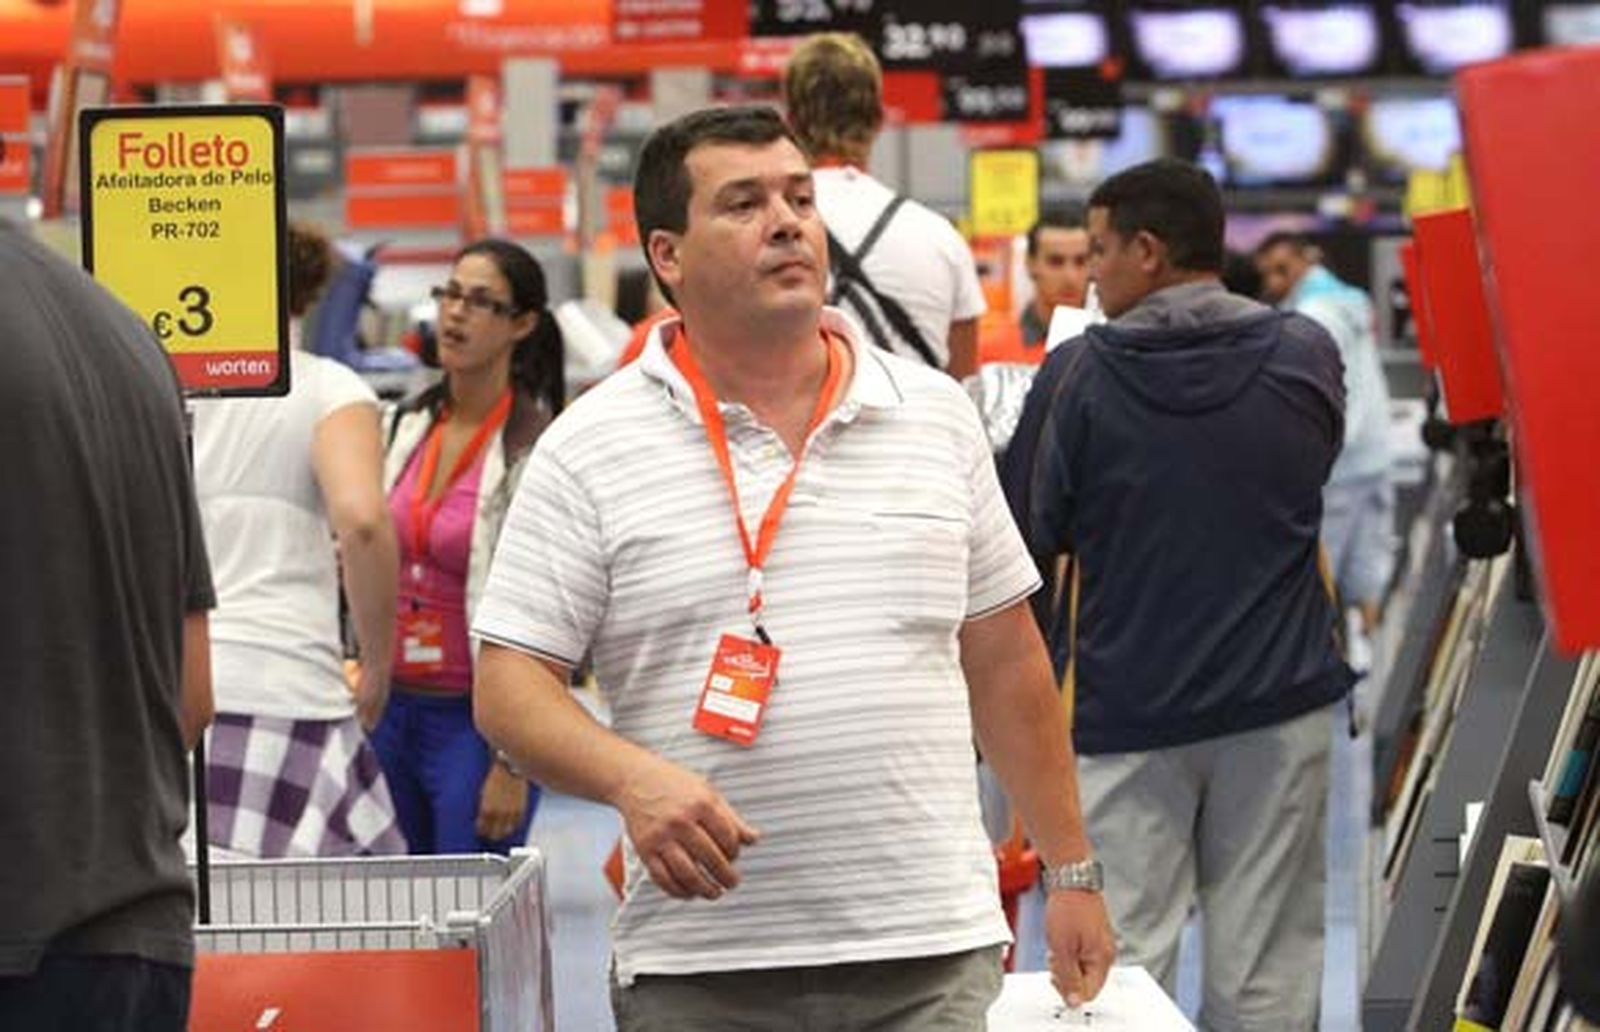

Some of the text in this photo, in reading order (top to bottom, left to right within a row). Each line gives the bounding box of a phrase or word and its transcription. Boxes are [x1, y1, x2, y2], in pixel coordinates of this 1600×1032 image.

[118, 132, 249, 168] Folleto
[96, 170, 273, 189] Afeitadora de Pelo
[148, 198, 221, 213] Becken
[151, 222, 220, 239] PR-702
[206, 357, 270, 376] worten
